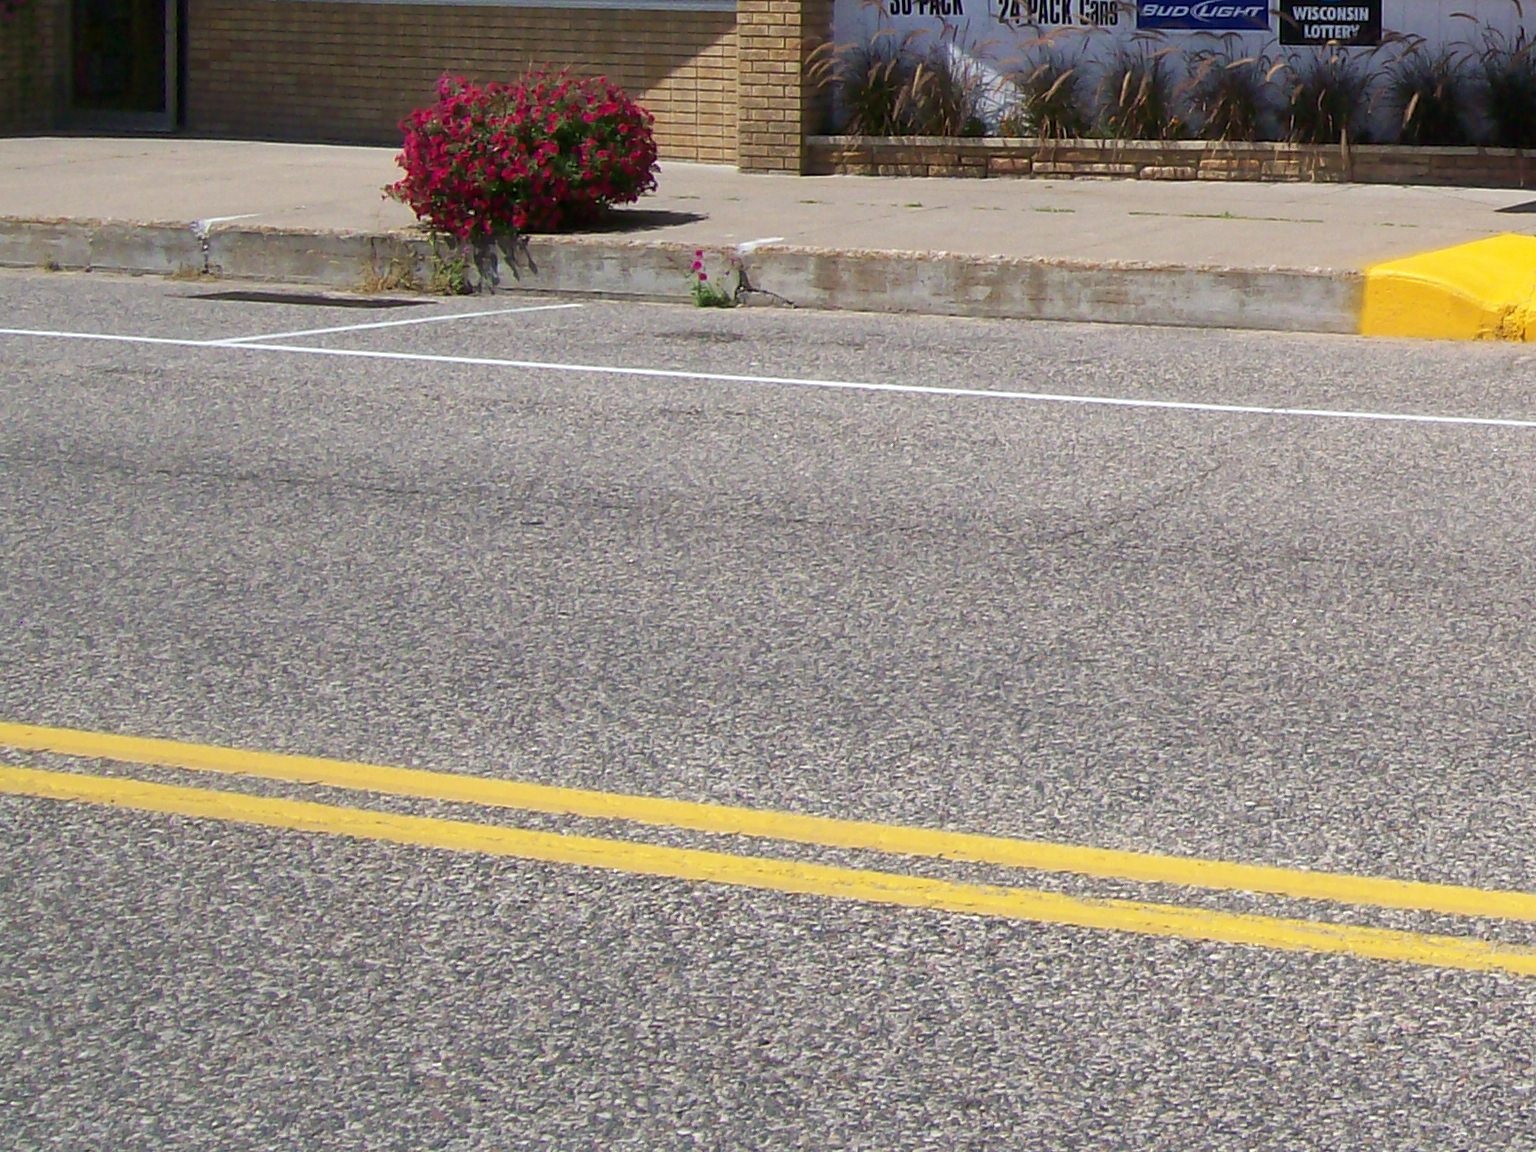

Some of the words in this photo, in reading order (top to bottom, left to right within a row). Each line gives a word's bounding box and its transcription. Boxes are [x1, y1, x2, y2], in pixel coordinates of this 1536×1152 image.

[1141, 4, 1189, 17] BUD
[1199, 6, 1264, 18] LIGHT
[1292, 7, 1369, 21] WISCONSIN
[1304, 24, 1360, 39] LOTTERY
